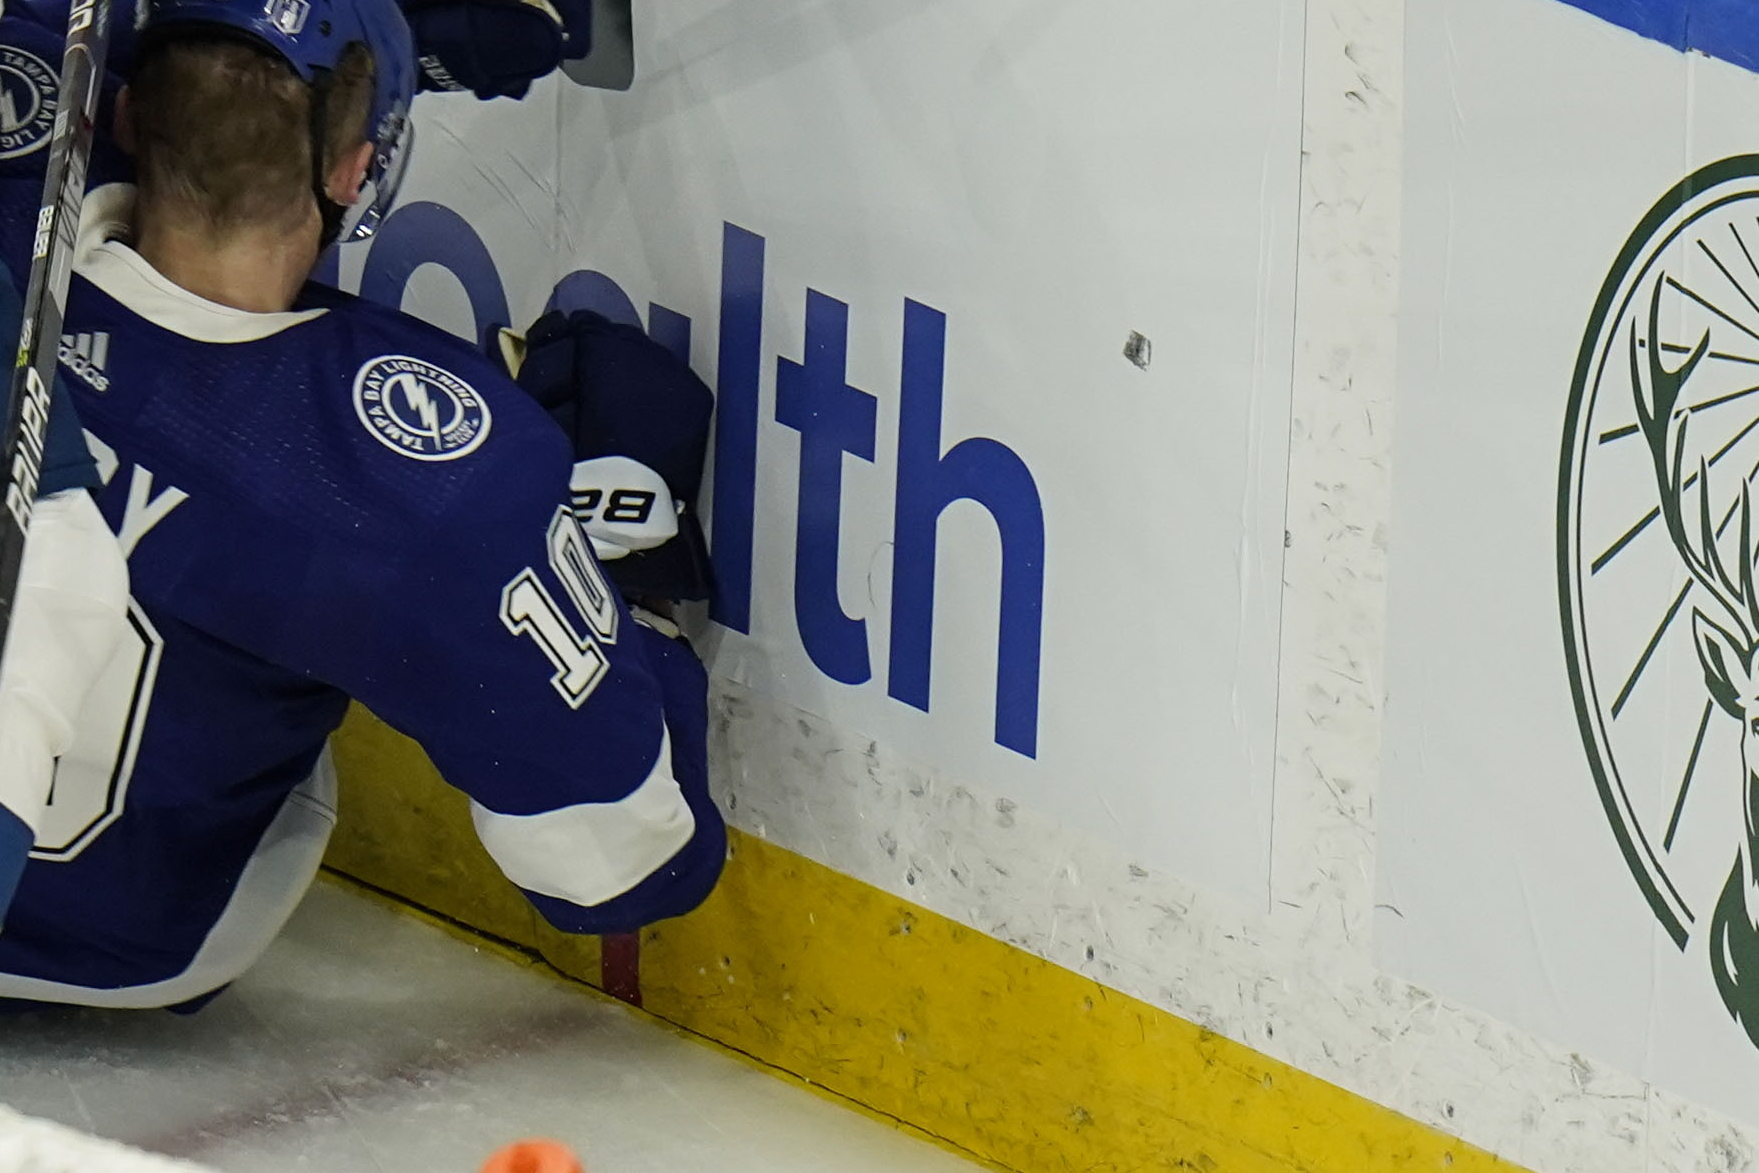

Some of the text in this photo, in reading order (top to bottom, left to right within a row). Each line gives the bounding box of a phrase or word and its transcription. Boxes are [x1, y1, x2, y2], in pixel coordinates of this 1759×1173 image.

[362, 369, 386, 401] BAY
[380, 360, 478, 408] LIGHTNING
[368, 405, 425, 450] TAMPA
[498, 503, 619, 711] 10
